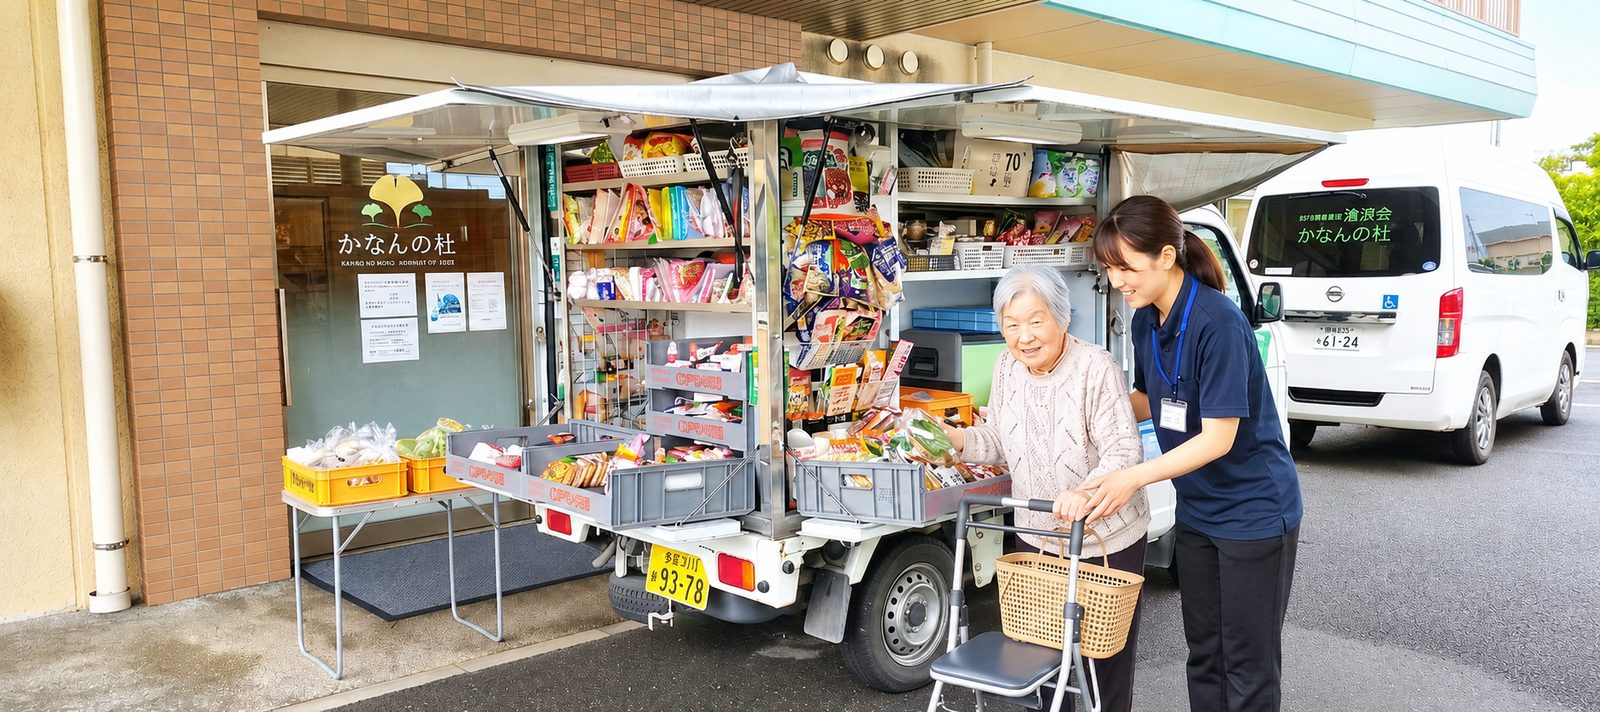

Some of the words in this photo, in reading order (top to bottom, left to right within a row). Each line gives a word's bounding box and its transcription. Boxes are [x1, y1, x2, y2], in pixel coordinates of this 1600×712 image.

[1006, 153, 1021, 171] 70
[1298, 224, 1391, 243] かなんの杜
[338, 233, 456, 256] かなんの杜
[1323, 335, 1358, 348] 61-24
[659, 568, 704, 604] 93-78
